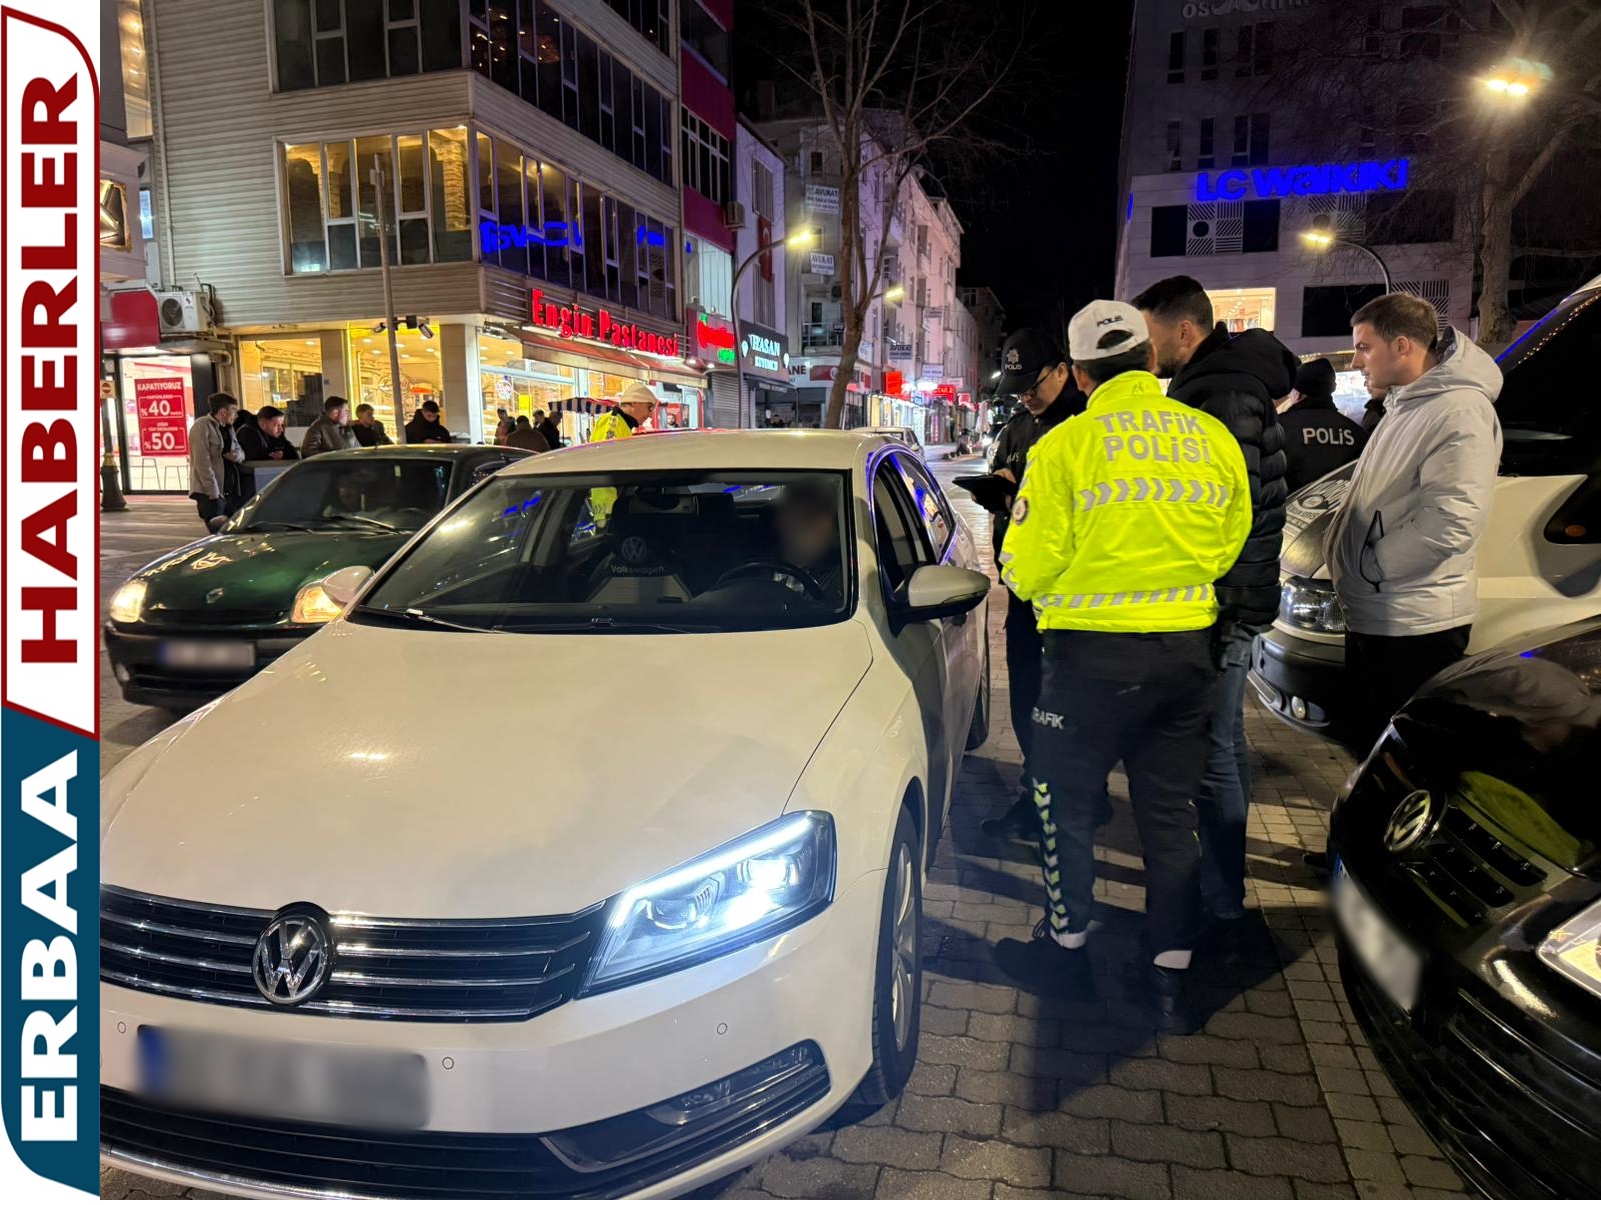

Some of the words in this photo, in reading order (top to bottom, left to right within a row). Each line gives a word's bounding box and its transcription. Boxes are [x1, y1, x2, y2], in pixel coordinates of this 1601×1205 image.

[1197, 169, 1248, 202] LC
[812, 255, 833, 264] AVUKAT
[532, 288, 593, 338] Engin
[599, 308, 679, 357] Pastanesi
[137, 382, 182, 392] KAPATIYORUZ
